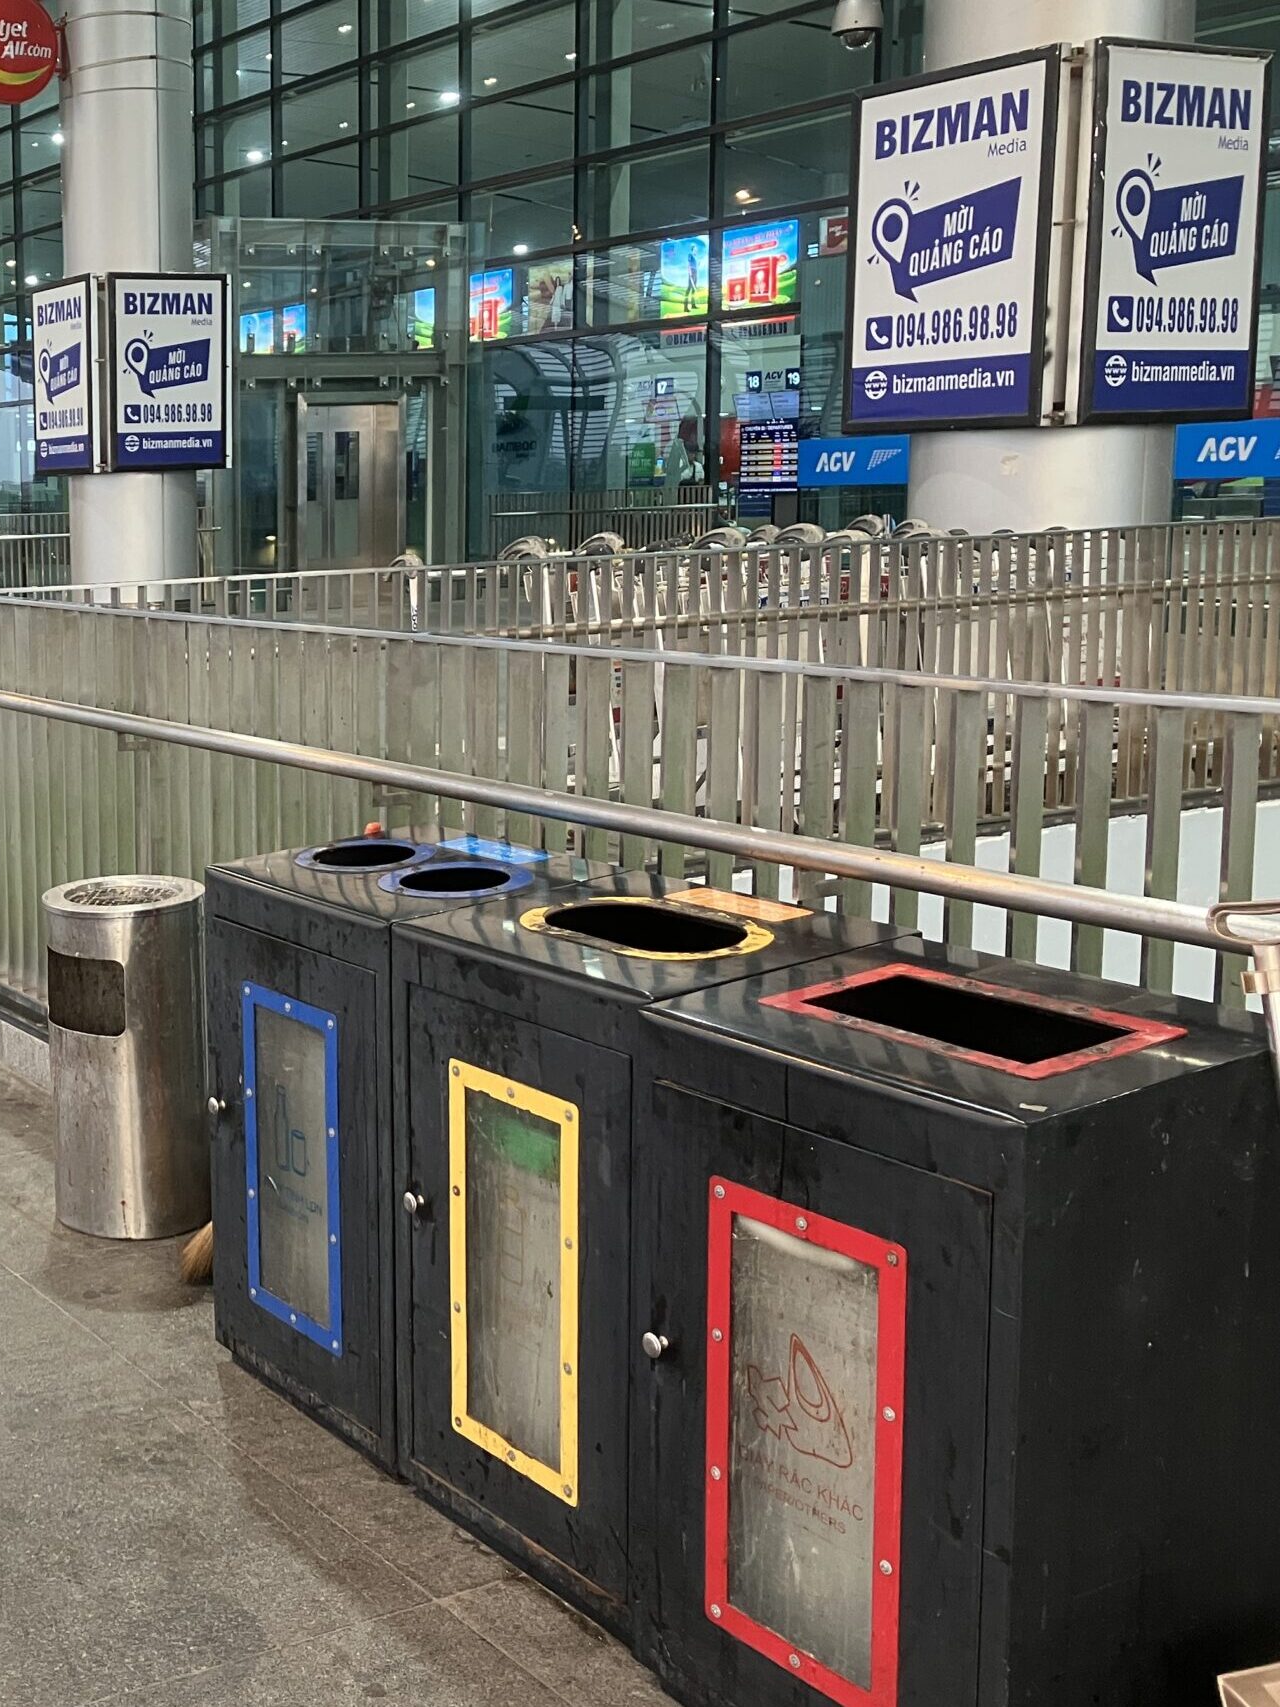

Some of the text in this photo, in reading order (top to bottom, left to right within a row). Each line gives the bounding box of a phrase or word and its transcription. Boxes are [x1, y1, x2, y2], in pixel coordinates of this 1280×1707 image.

[1121, 80, 1252, 130] BIZMAN
[875, 89, 1029, 160] BIZMAN
[988, 138, 1027, 157] Media
[1218, 135, 1249, 151] Media
[1180, 191, 1207, 222] MỜI
[943, 204, 974, 238] MỜI
[1149, 218, 1229, 258] QUẢNG CÁO
[909, 226, 1003, 277] QUẢNG CÁO
[37, 296, 81, 327] BIZMAN
[124, 292, 212, 315] BIZMAN
[1136, 296, 1239, 333] 094.986.98.98
[191, 318, 213, 326] Media
[896, 301, 1018, 348] 094.986.98.98
[183, 361, 202, 379] CÁO
[747, 376, 760, 388] 18
[787, 372, 800, 385] 19
[893, 367, 1015, 394] bizmanmedia.vn
[1132, 360, 1235, 382] bizmanmedia.vn
[143, 403, 212, 424] 094.986.98.98
[142, 437, 213, 449] bizmanmedia.vn
[1197, 436, 1258, 462] ACV
[815, 451, 856, 472] ACV
